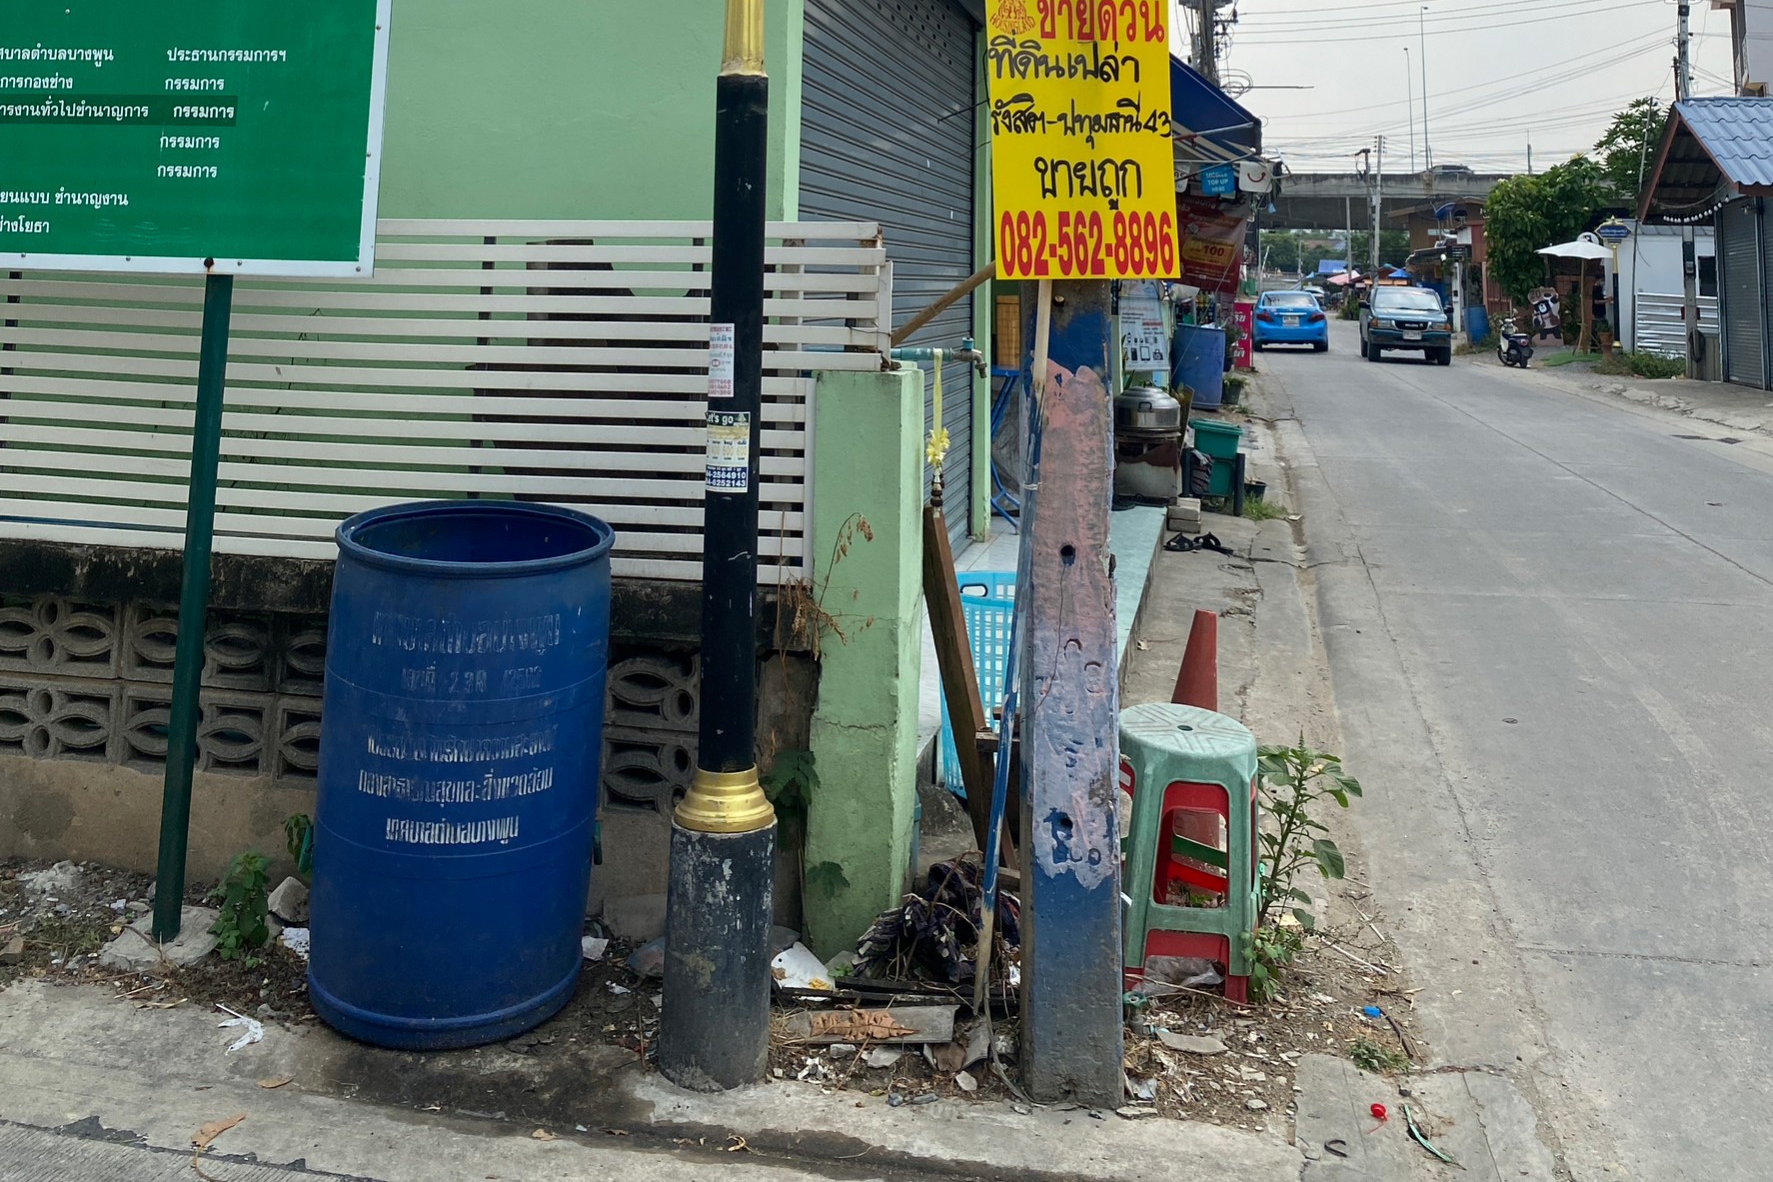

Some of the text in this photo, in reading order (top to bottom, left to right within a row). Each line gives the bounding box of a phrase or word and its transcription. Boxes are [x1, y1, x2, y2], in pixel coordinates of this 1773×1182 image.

[166, 47, 287, 62] ประธานกรรมการฯ
[988, 30, 1141, 83] ที่ดินเปล่า
[164, 78, 225, 90] กรรมการ
[173, 106, 235, 118] กรรมการ
[160, 136, 220, 149] กรรมการ
[157, 165, 218, 178] กรรมการ
[1034, 156, 1143, 210] ขายถูก
[55, 186, 129, 209] ชำนาญงาน
[1000, 210, 1174, 276] 082-562-8896
[1204, 245, 1225, 257] 100
